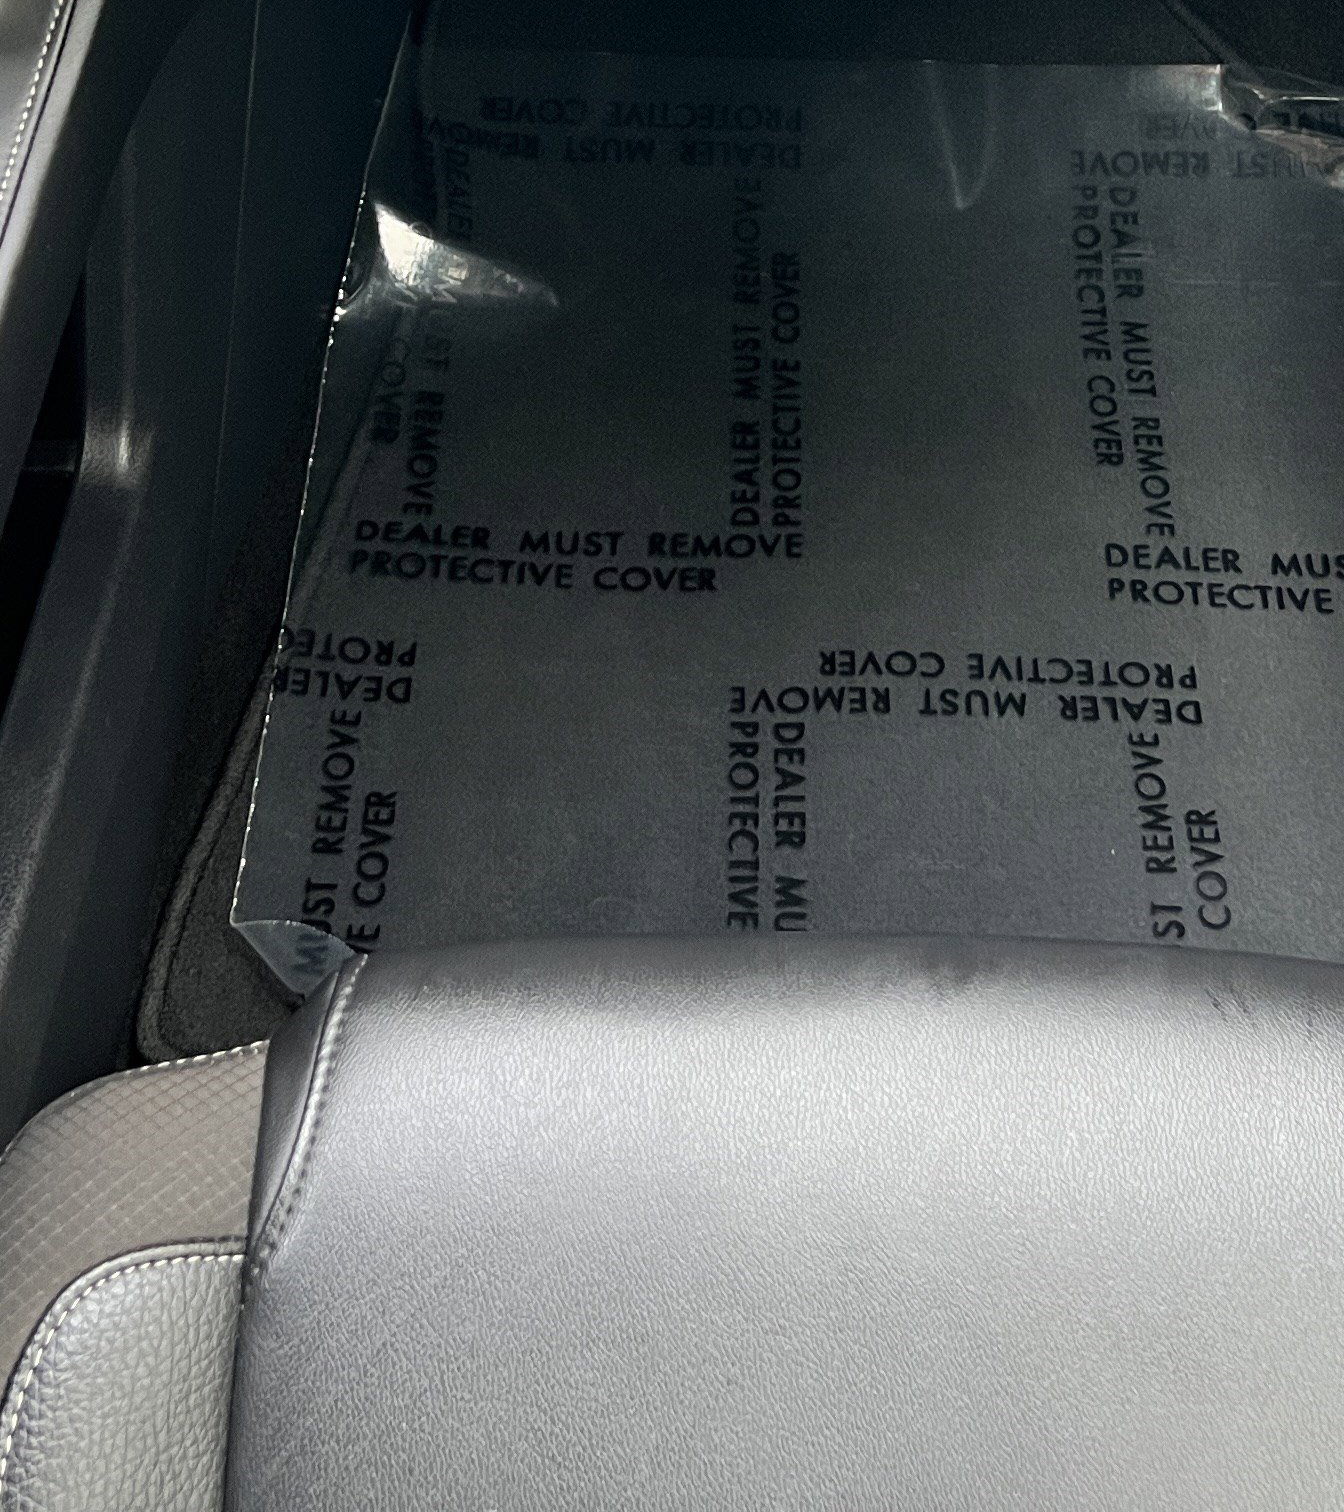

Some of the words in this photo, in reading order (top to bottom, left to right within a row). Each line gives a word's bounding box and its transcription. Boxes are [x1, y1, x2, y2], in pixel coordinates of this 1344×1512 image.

[478, 96, 590, 126] COVER
[564, 136, 656, 164] MUST
[606, 100, 807, 136] PROTECTIVE
[679, 140, 801, 171] DEALER
[1072, 148, 1211, 180] REMOVE
[734, 177, 762, 308] REMOVE
[1070, 184, 1114, 362] PROTECTIVE
[1106, 187, 1146, 300] DEALER
[769, 250, 800, 341] COVER
[371, 337, 409, 445] COVER
[730, 318, 762, 402] MUST
[1119, 318, 1158, 399] MUST
[404, 390, 446, 518] REMOVE
[770, 358, 803, 529] PROTECTIVE
[1086, 368, 1125, 468] COVER
[729, 419, 762, 530] DEALER
[1130, 415, 1176, 538] REMOVE
[347, 548, 574, 590] PROTECTIVE
[591, 563, 720, 594] COVER
[355, 519, 492, 552] DEALER
[517, 529, 624, 559] MUST
[646, 532, 806, 560] REMOVE
[1104, 542, 1243, 577] DEALER
[1107, 579, 1335, 616] PROTECTIVE
[729, 686, 891, 716] REMOVE
[818, 649, 946, 678] COVER
[918, 688, 1027, 718] MUST
[967, 654, 1199, 690] PROTECTIVE
[1057, 692, 1203, 725] DEALER
[309, 708, 362, 856] REMOVE
[773, 721, 807, 851] DEALER
[1128, 731, 1177, 875] REMOVE
[350, 790, 398, 908] COVER
[726, 720, 761, 933] PROTECTIVE
[1183, 807, 1233, 931] COVER
